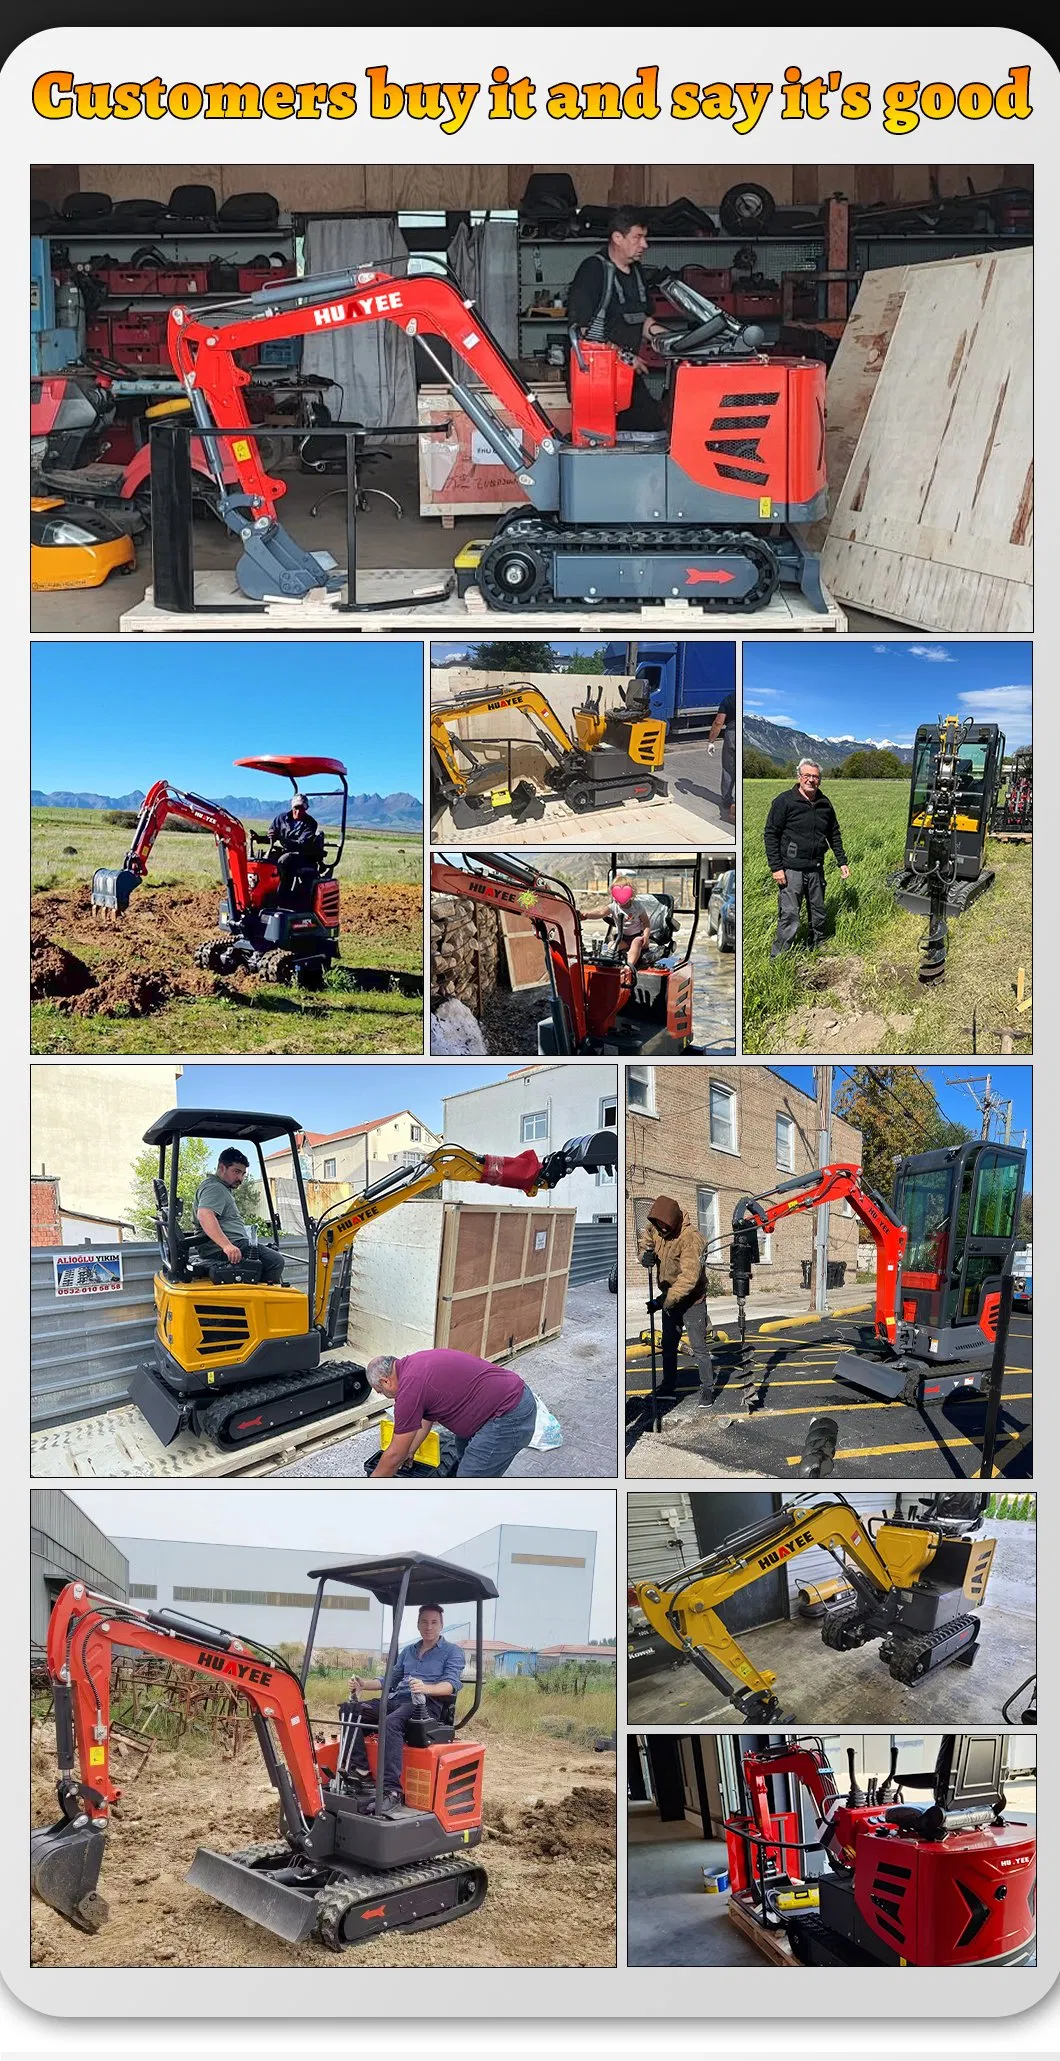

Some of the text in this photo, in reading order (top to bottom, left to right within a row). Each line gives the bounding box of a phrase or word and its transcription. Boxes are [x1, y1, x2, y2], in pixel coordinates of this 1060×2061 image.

[313, 292, 403, 326] HUAYEE
[487, 696, 523, 710] HUAYEE
[468, 882, 516, 903] HUAYEE
[336, 1206, 379, 1233] HUAYEE
[758, 1531, 815, 1570] HUAYEE
[197, 1651, 273, 1687] HUAYEE
